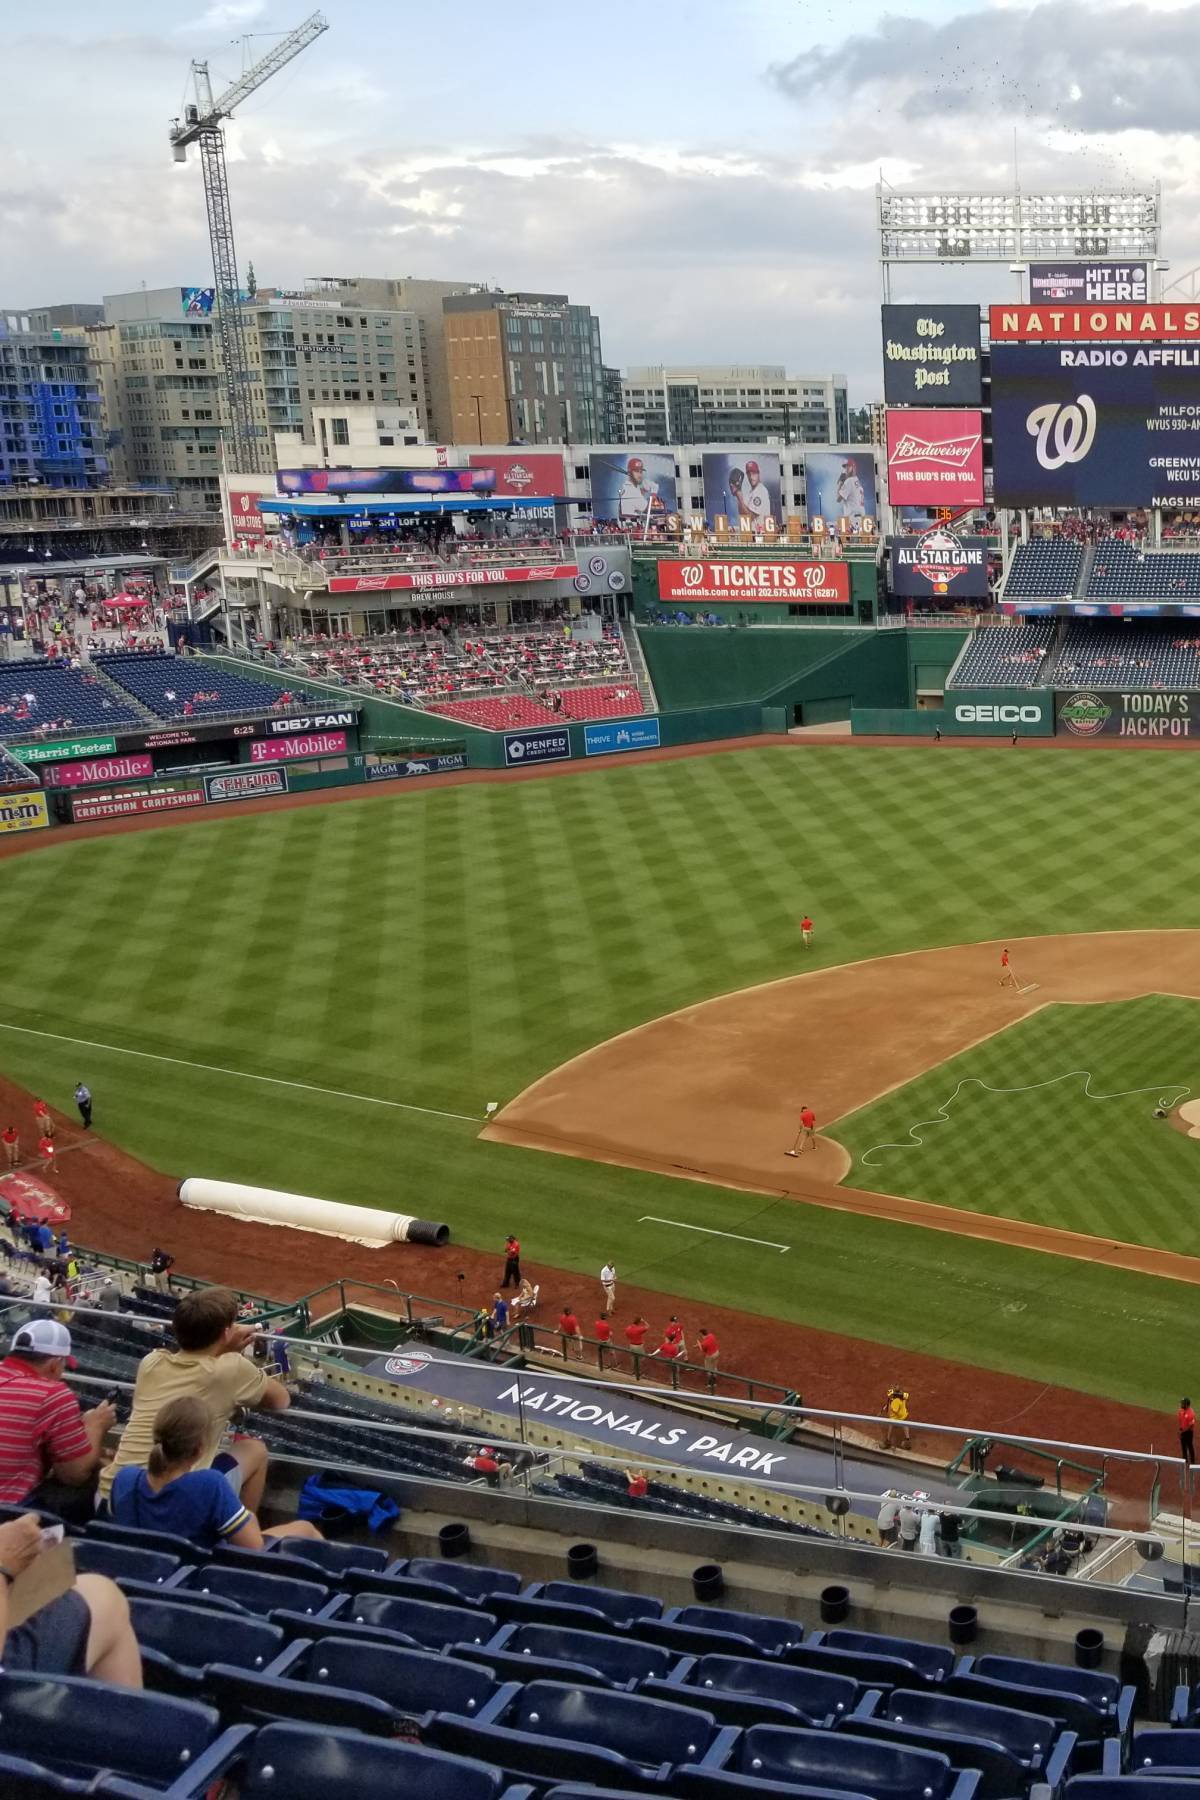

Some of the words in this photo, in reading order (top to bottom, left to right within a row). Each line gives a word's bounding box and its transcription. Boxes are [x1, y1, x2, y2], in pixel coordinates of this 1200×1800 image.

[1086, 269, 1111, 282] HIT
[1115, 269, 1130, 282] IT
[1086, 282, 1146, 301] HERE
[916, 318, 945, 339] The
[1002, 312, 1200, 332] NATIONALS
[886, 339, 977, 365] Washington
[1060, 350, 1128, 366] RADIO
[914, 368, 950, 390] Post
[1146, 419, 1171, 431] WYUS
[895, 441, 972, 457] Budweiser
[895, 471, 914, 482] THIS
[915, 471, 939, 482] BUD'S
[940, 472, 957, 482] FOR
[957, 472, 976, 482] YOU.
[1166, 470, 1190, 481] WECU
[1152, 497, 1184, 506] NAGS
[232, 515, 246, 528] TEAM
[246, 515, 262, 529] STORE
[398, 518, 420, 526] LOFT
[668, 515, 775, 532] SWING
[814, 517, 873, 532] BIG
[898, 550, 919, 564] ALL
[920, 550, 950, 564] STAR
[952, 550, 983, 565] GAME
[410, 574, 435, 586] THIS
[435, 573, 464, 585] BUD'S
[466, 572, 484, 584] FOR
[484, 570, 508, 582] YOU.
[710, 565, 796, 586] TICKETS
[411, 592, 431, 602] BREW
[432, 591, 455, 601] HOUSE
[671, 587, 729, 597] nationals.com
[730, 588, 739, 597] or
[740, 587, 757, 597] call
[758, 587, 812, 598] 202.675.NATS
[814, 587, 838, 599] (6287)
[1121, 694, 1189, 713] TODAY'S
[315, 713, 352, 728] FAN
[955, 705, 1042, 722] GEICO
[233, 726, 254, 735] 6:25
[1119, 717, 1191, 736] JACKPOT
[144, 739, 179, 748] NATIONALS
[180, 737, 197, 745] PARK
[149, 732, 180, 741] WELCOME
[181, 731, 190, 739] TO
[587, 735, 611, 746] THRIVE
[526, 738, 565, 750] PENFED
[547, 746, 566, 754] UNION
[27, 748, 69, 761] Harris
[71, 743, 113, 756] Teeter
[354, 757, 363, 766] 377
[438, 755, 463, 765] MGM
[371, 765, 398, 775] MGM
[76, 801, 137, 819] CRAFTSMAN
[142, 792, 201, 811] CRAFTSMAN
[497, 1383, 684, 1446] NATIONALS
[686, 1434, 787, 1475] PARK
